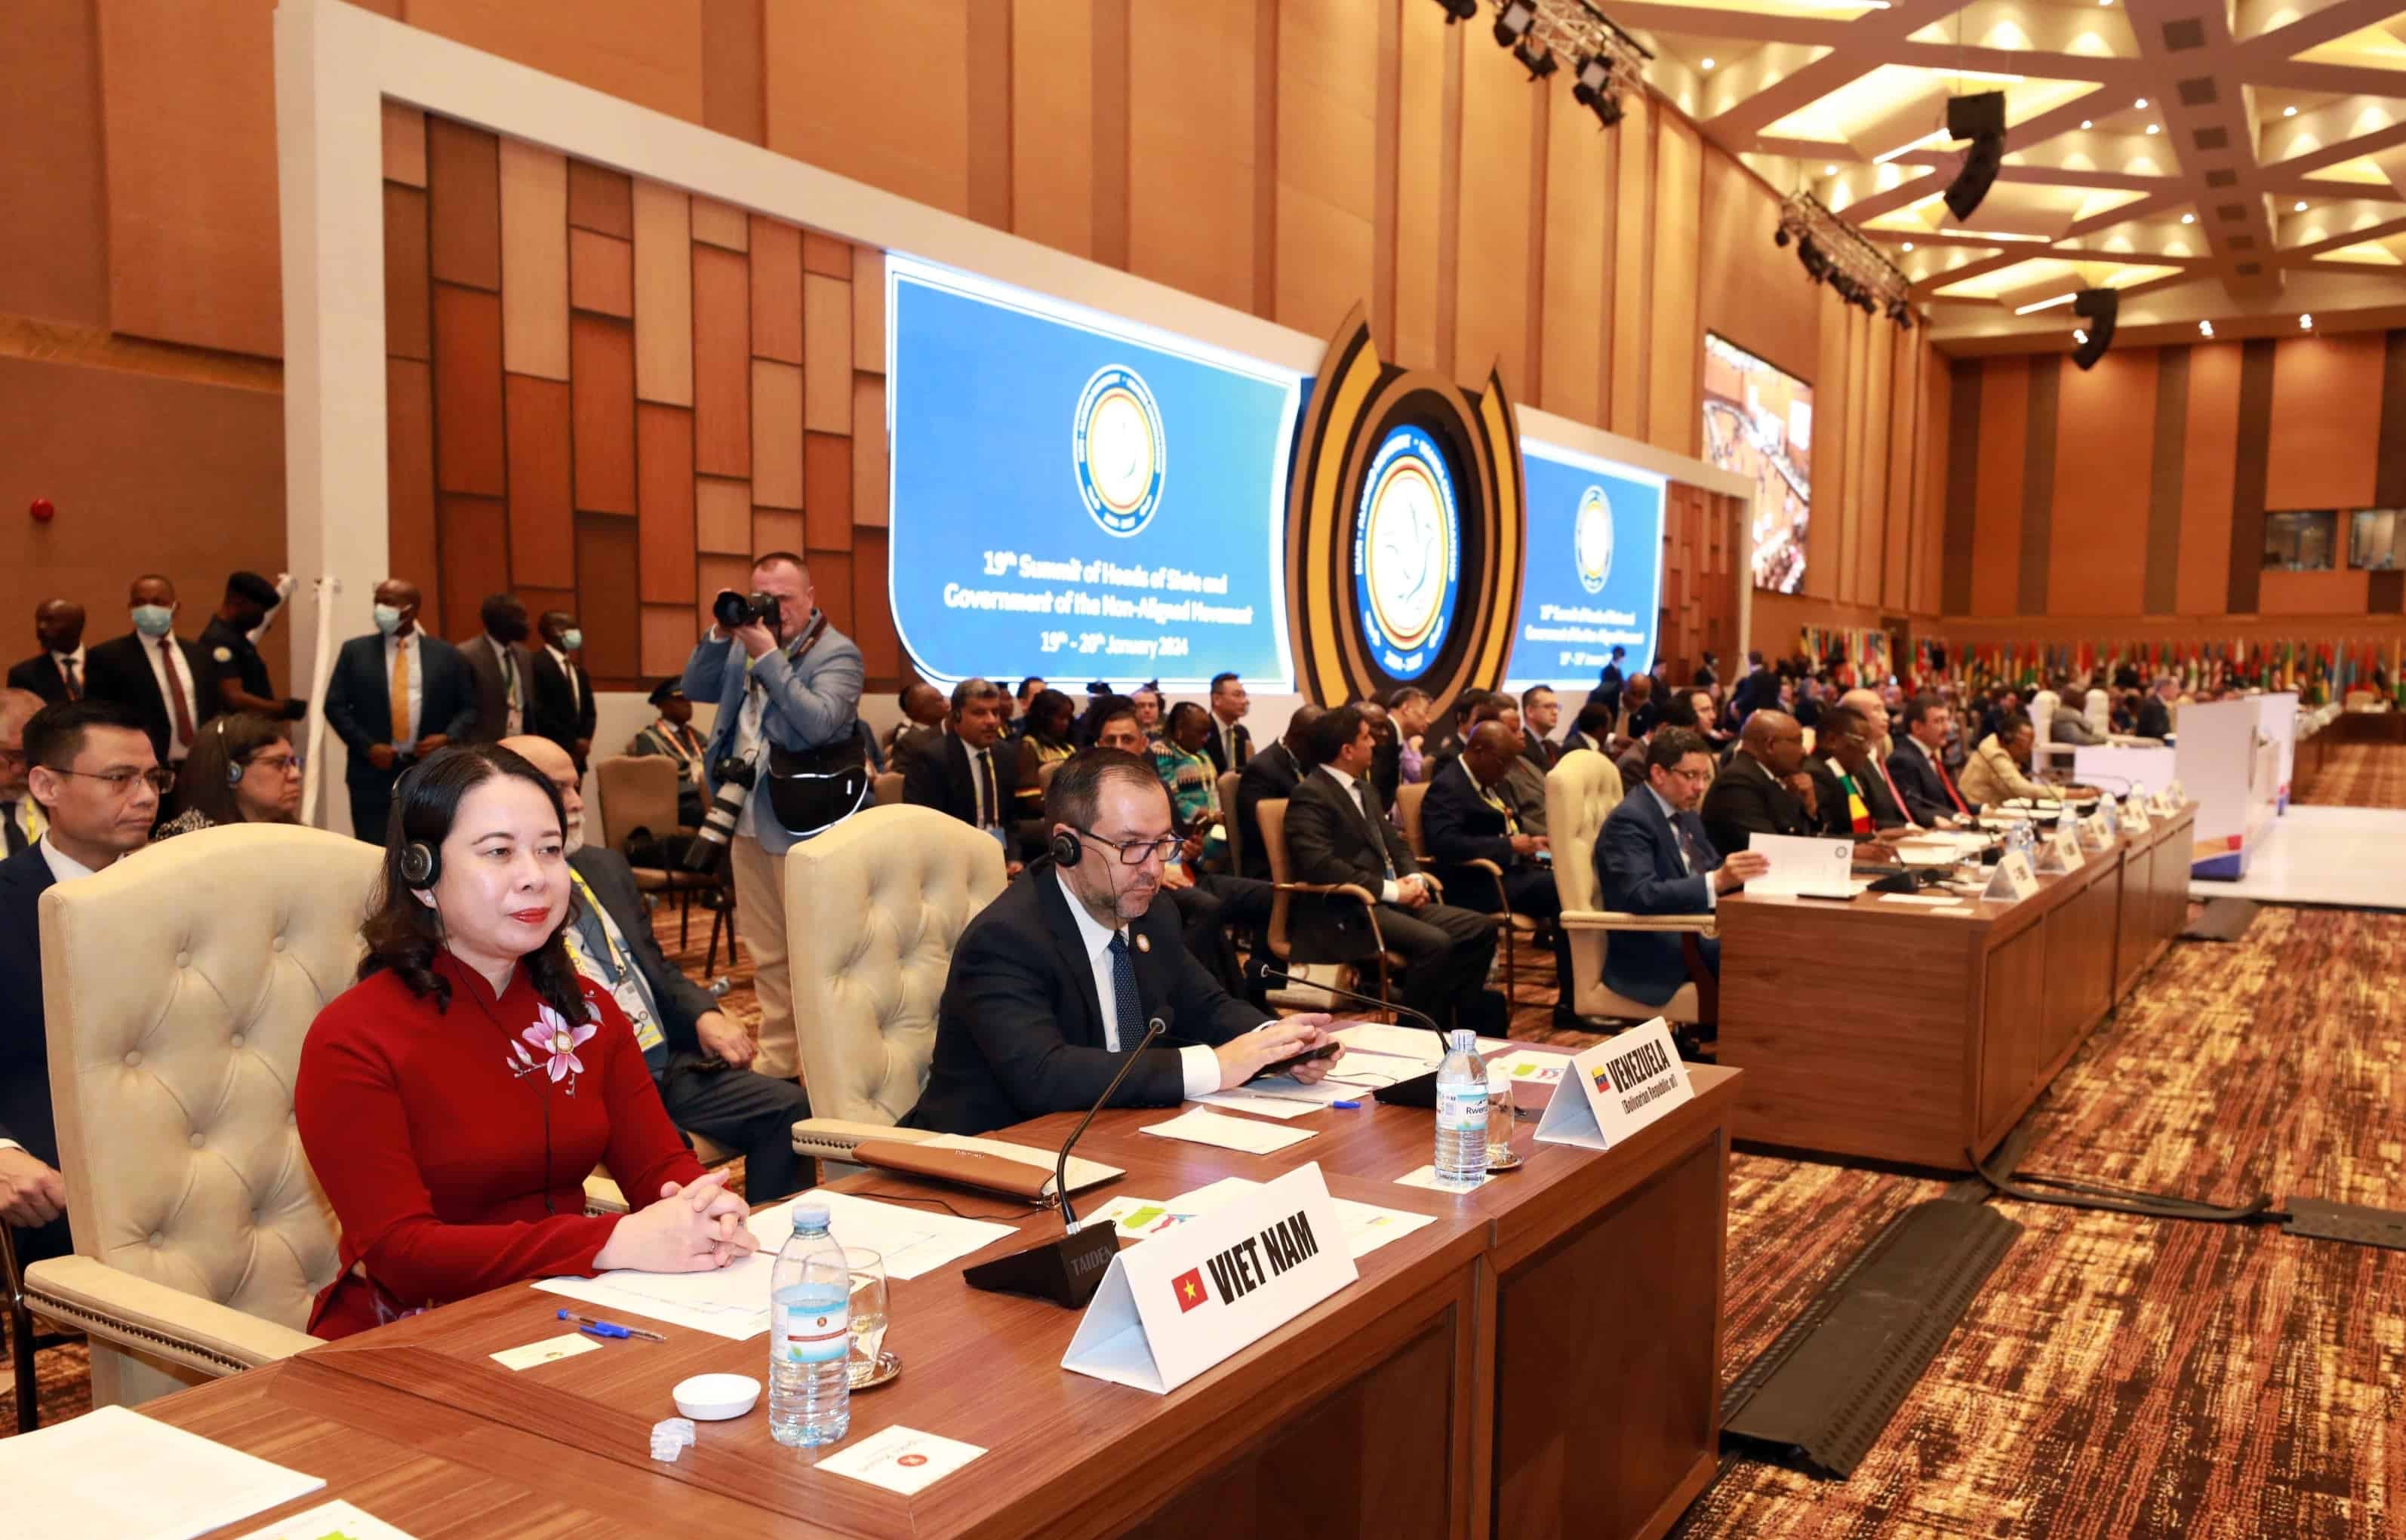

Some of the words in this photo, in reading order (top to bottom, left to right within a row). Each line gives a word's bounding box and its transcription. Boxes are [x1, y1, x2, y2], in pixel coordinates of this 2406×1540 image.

[1019, 553, 1082, 582] Summit
[1083, 559, 1101, 583] of
[1102, 561, 1149, 588] Heads
[1149, 566, 1168, 589] of
[1167, 568, 1202, 592] State
[1202, 573, 1228, 594] and
[944, 582, 1054, 613] Government
[1054, 589, 1074, 614] of
[1074, 591, 1100, 616] the
[1102, 594, 1190, 625] Non-Aligned
[1191, 600, 1254, 625] Movement
[1106, 635, 1158, 660] January
[1606, 1038, 1671, 1093] VENEZUELA
[1206, 1237, 1266, 1305] VIET
[1260, 1210, 1319, 1277] NAM
